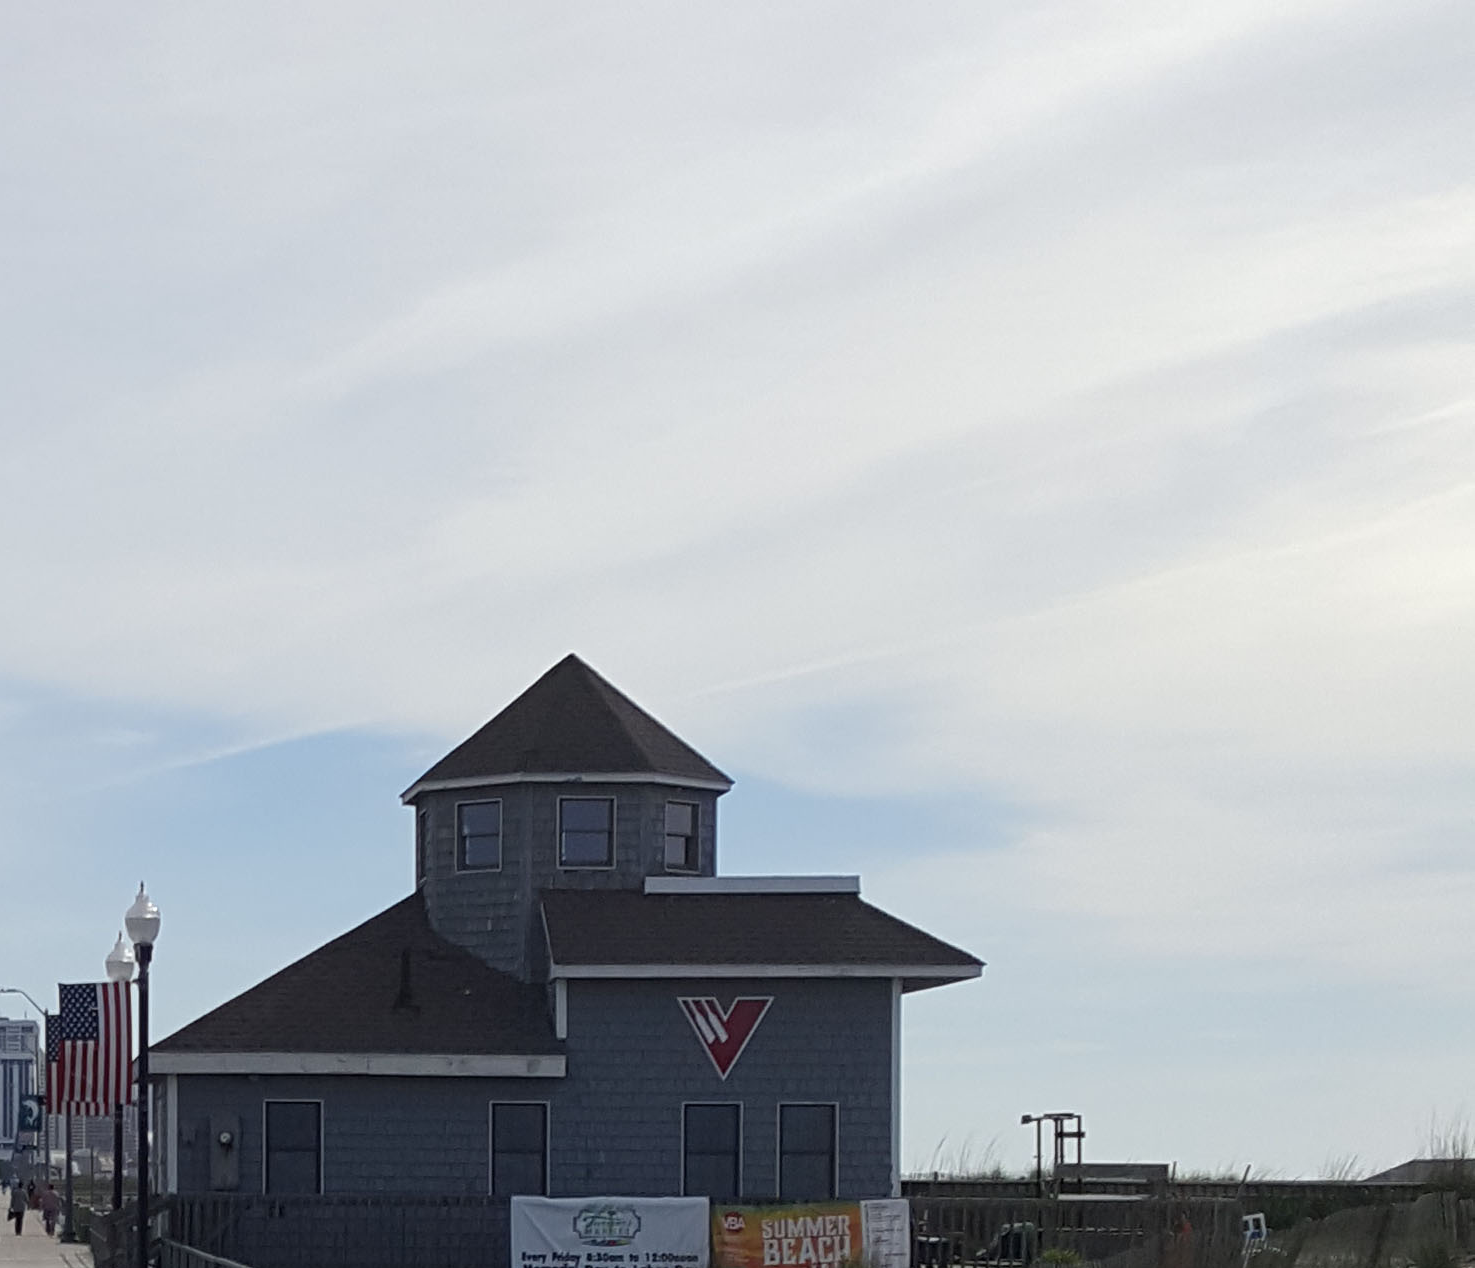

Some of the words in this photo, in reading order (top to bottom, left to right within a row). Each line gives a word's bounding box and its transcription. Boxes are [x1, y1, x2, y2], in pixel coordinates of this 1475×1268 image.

[761, 1215, 851, 1239] SUMMER
[521, 1252, 547, 1264] Every
[552, 1252, 582, 1265] Friday
[629, 1252, 640, 1263] to
[763, 1236, 851, 1266] BEACH
